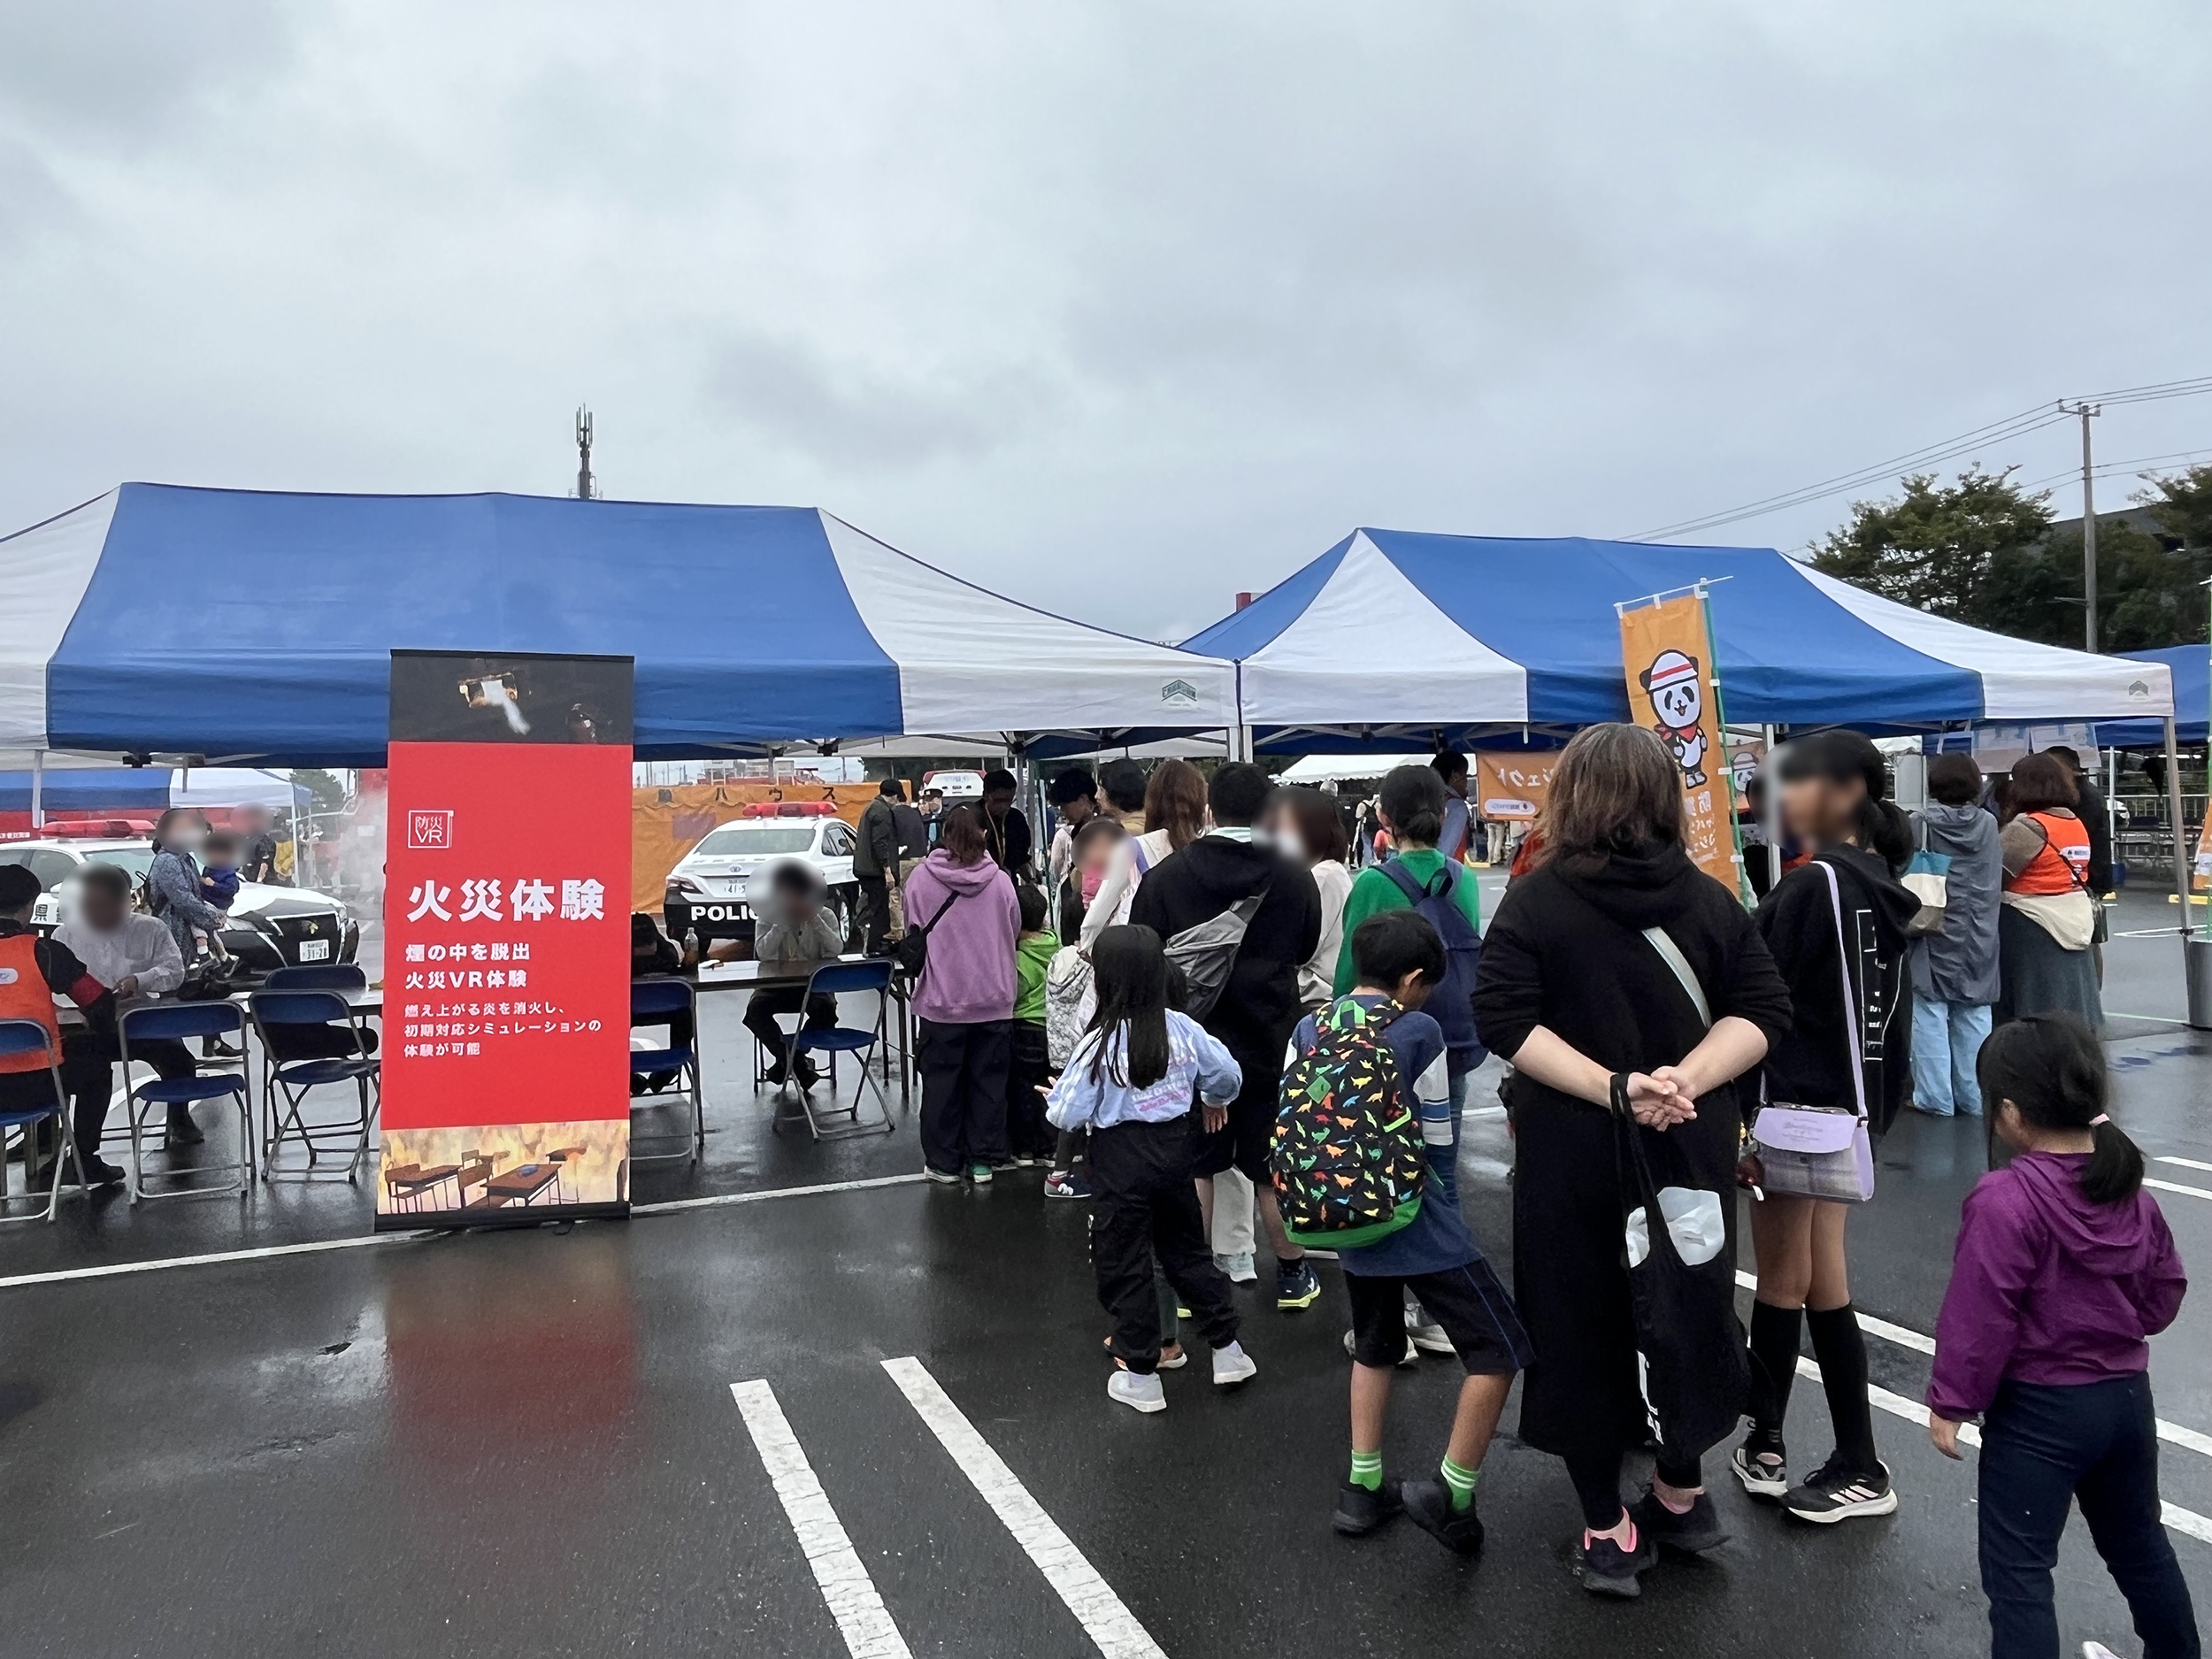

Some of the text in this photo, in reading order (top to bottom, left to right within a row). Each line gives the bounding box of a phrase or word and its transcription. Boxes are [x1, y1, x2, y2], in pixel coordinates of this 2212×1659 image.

[415, 816, 442, 831] 防災
[415, 829, 442, 843] VR
[406, 878, 605, 922] 火災体験
[405, 942, 530, 962] 煙の中を脱出
[405, 969, 527, 990] 火災VR体験
[404, 1002, 565, 1018] 燃え上がる炎を消火し、
[403, 1019, 602, 1038] 初期対応シミュレーションの
[403, 1042, 481, 1058] 体験が可能
